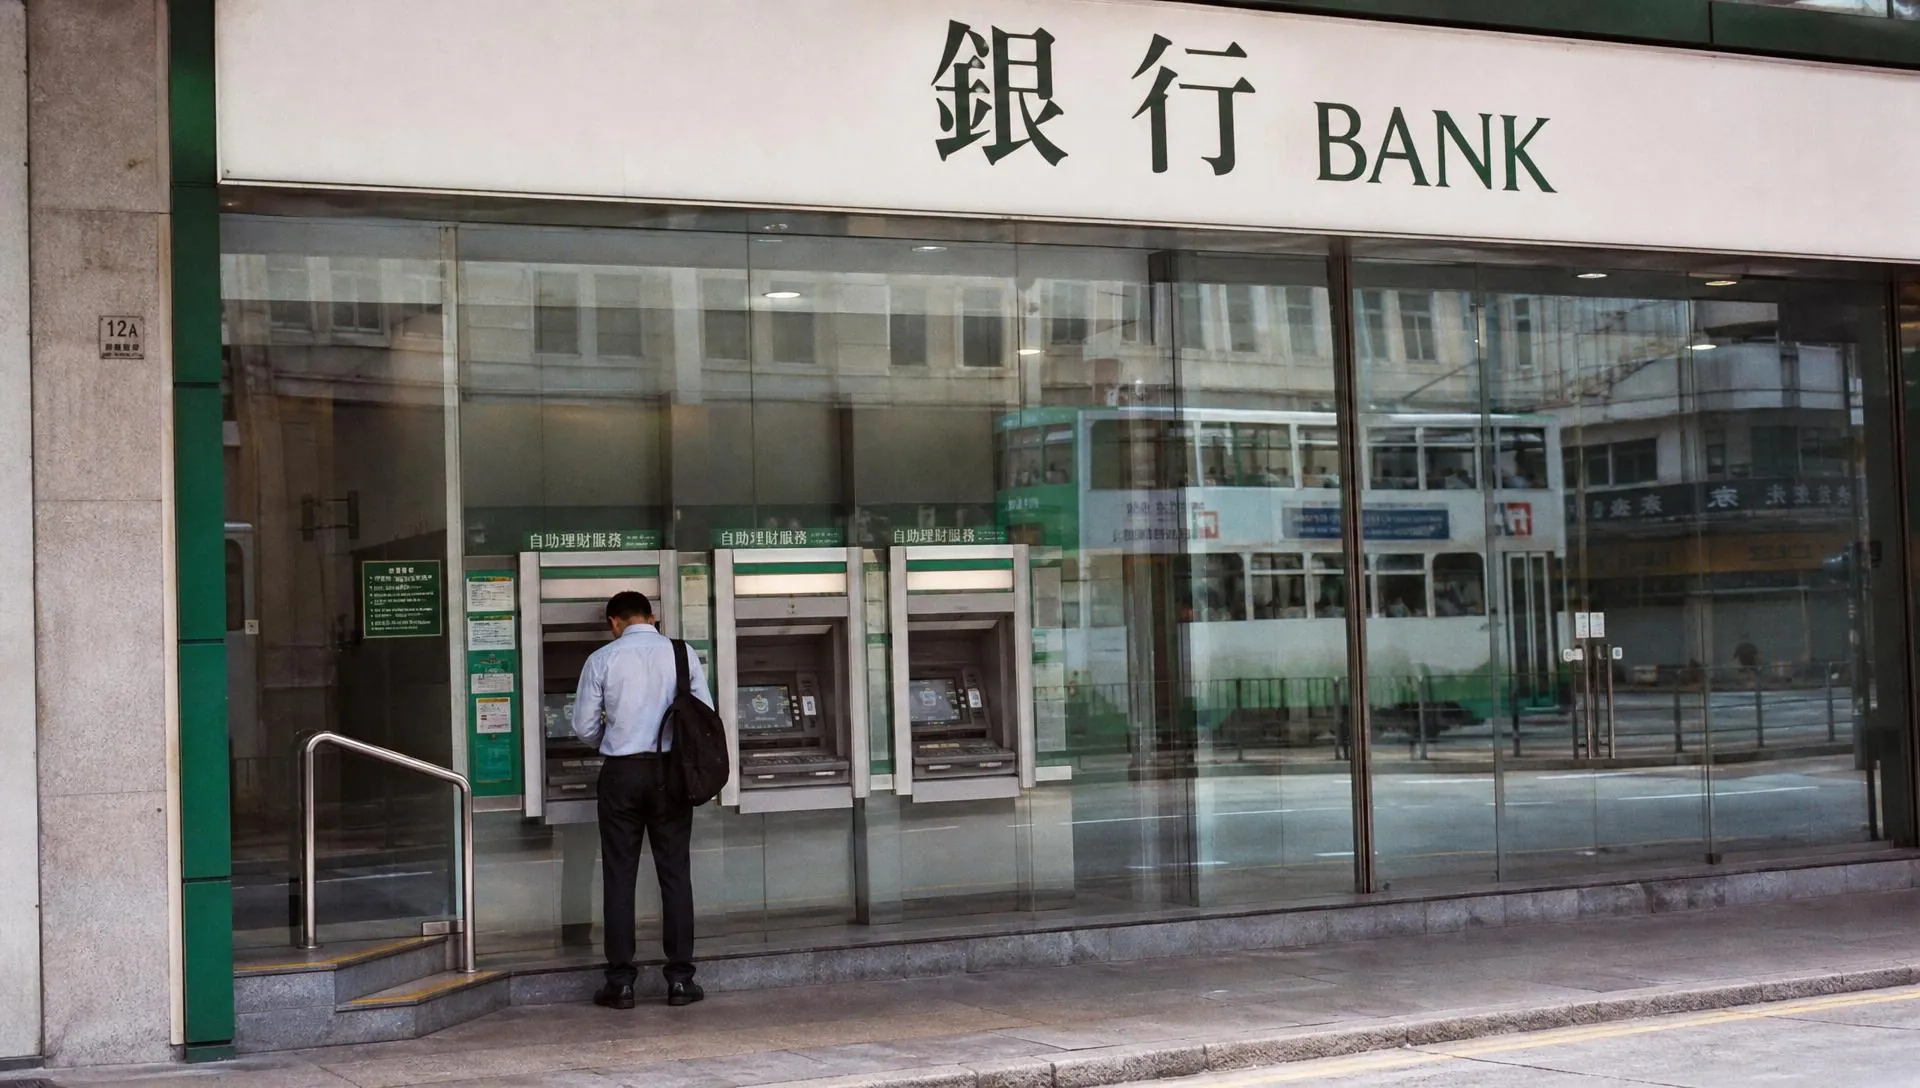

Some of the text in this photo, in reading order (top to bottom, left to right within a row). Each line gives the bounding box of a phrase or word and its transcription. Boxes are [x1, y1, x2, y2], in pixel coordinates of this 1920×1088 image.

[932, 20, 1558, 193] 銀行 BANK
[107, 320, 138, 338] 12A
[530, 532, 622, 549] 自助理財服務
